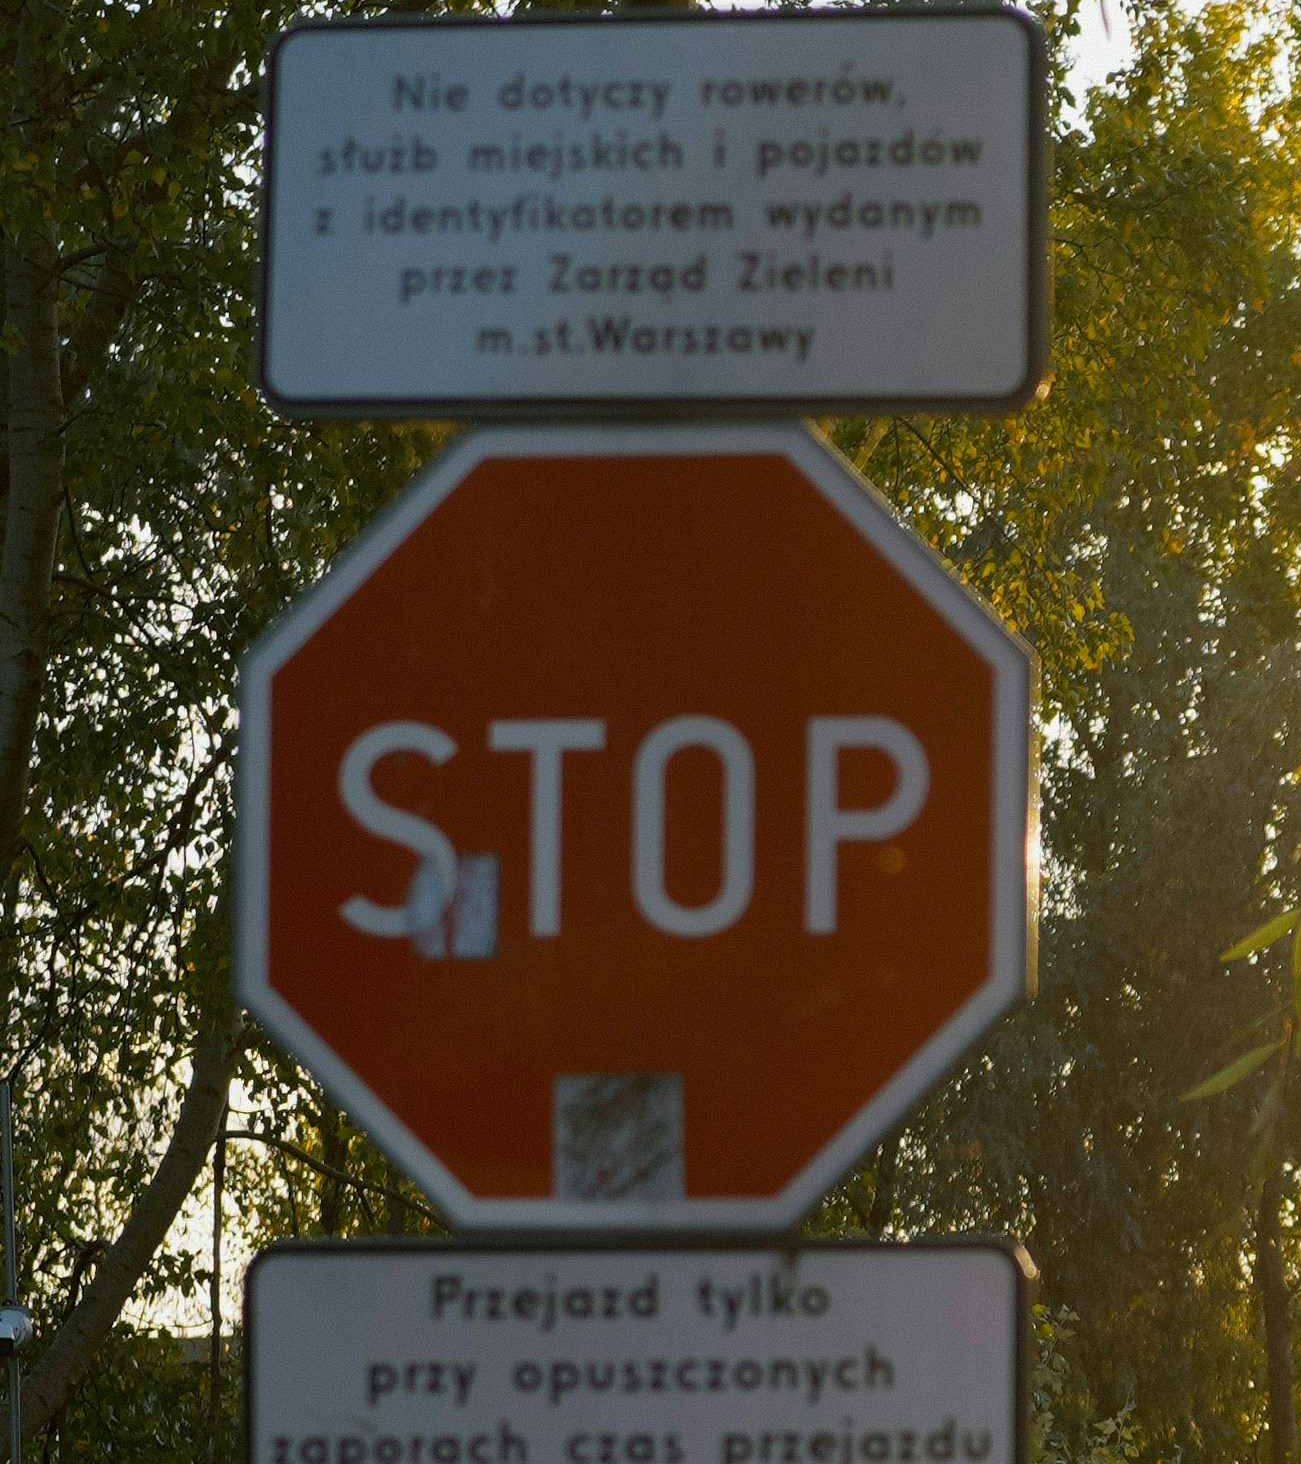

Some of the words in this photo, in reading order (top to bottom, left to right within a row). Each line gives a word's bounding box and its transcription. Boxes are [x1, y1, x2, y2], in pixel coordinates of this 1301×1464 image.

[391, 75, 470, 112] Nie
[497, 72, 672, 118] dotyczy
[698, 62, 908, 113] rowerów,
[317, 135, 439, 177] służb
[467, 128, 684, 180] miejskich
[713, 130, 727, 168] i
[755, 127, 983, 178] pojazdów
[313, 210, 334, 236] z
[363, 196, 736, 242] identyfikatorem
[763, 193, 984, 240] wydanym
[398, 262, 519, 305] przez
[547, 252, 709, 304] Zarząd
[736, 249, 896, 293] Zieleni
[338, 713, 932, 938] STOP
[430, 1274, 661, 1330] Przejazd
[695, 1274, 832, 1331] tylko
[366, 1358, 478, 1406] przy
[511, 1344, 896, 1405] opuszczonych
